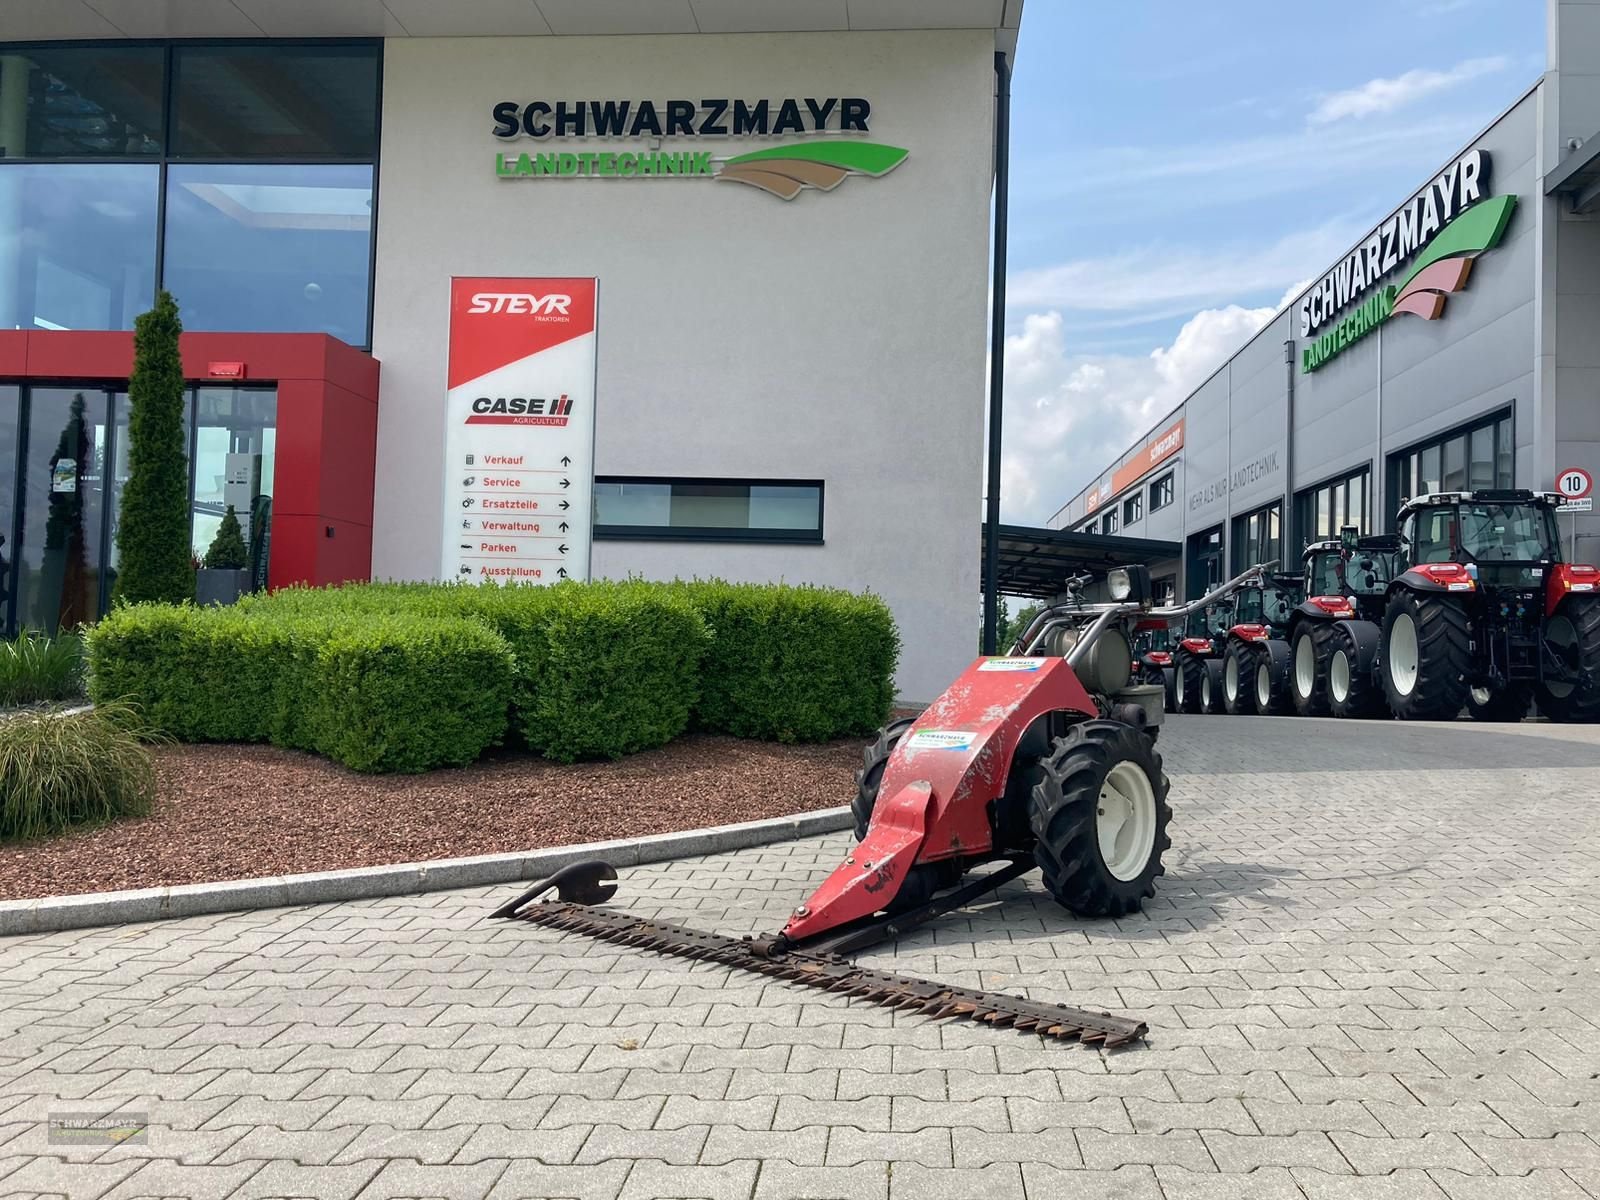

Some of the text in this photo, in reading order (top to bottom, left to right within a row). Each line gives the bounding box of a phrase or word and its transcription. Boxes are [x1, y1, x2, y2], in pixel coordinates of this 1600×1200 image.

[491, 98, 872, 139] SCHWARZMAYR
[495, 151, 713, 178] LANDTECHNIK
[1300, 149, 1492, 338] SCHWARZMAYR
[467, 292, 572, 315] STEYR
[1302, 285, 1397, 374] LANDTECHNIK
[472, 397, 545, 415] CASE
[512, 417, 566, 426] AGRICULTURE
[484, 455, 524, 465] Verkauf
[483, 477, 521, 488] Service
[1566, 476, 1580, 491] 10
[482, 499, 539, 510] Ersatzteile
[481, 521, 540, 534] Verwaltung
[481, 543, 517, 553] Parken
[480, 566, 542, 579] Ausstellung
